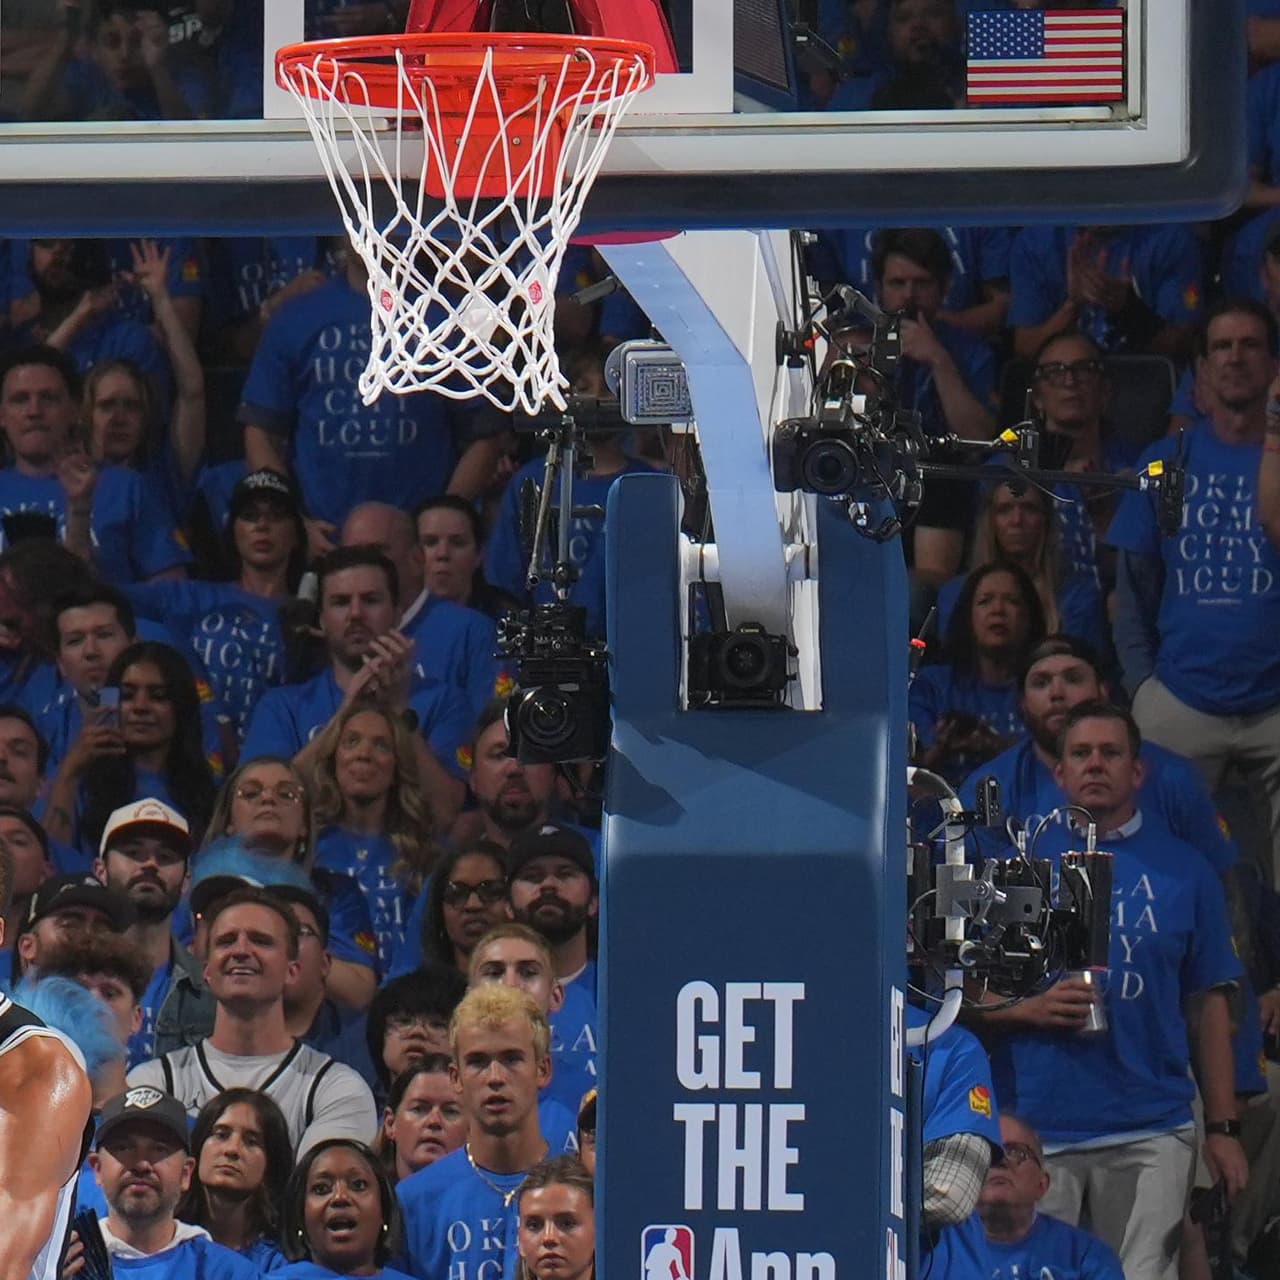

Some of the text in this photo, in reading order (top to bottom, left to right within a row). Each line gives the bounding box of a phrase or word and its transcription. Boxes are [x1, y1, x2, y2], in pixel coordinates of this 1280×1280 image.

[319, 327, 369, 353] OK
[318, 418, 418, 448] LOUD
[1184, 472, 1251, 500] OKL
[1180, 534, 1269, 563] CITY
[1177, 567, 1274, 594] LOUD
[200, 612, 277, 648] OKL
[192, 635, 277, 676] HOM
[677, 981, 805, 1090] GET
[673, 1103, 805, 1211] THE
[447, 1219, 506, 1253] OK
